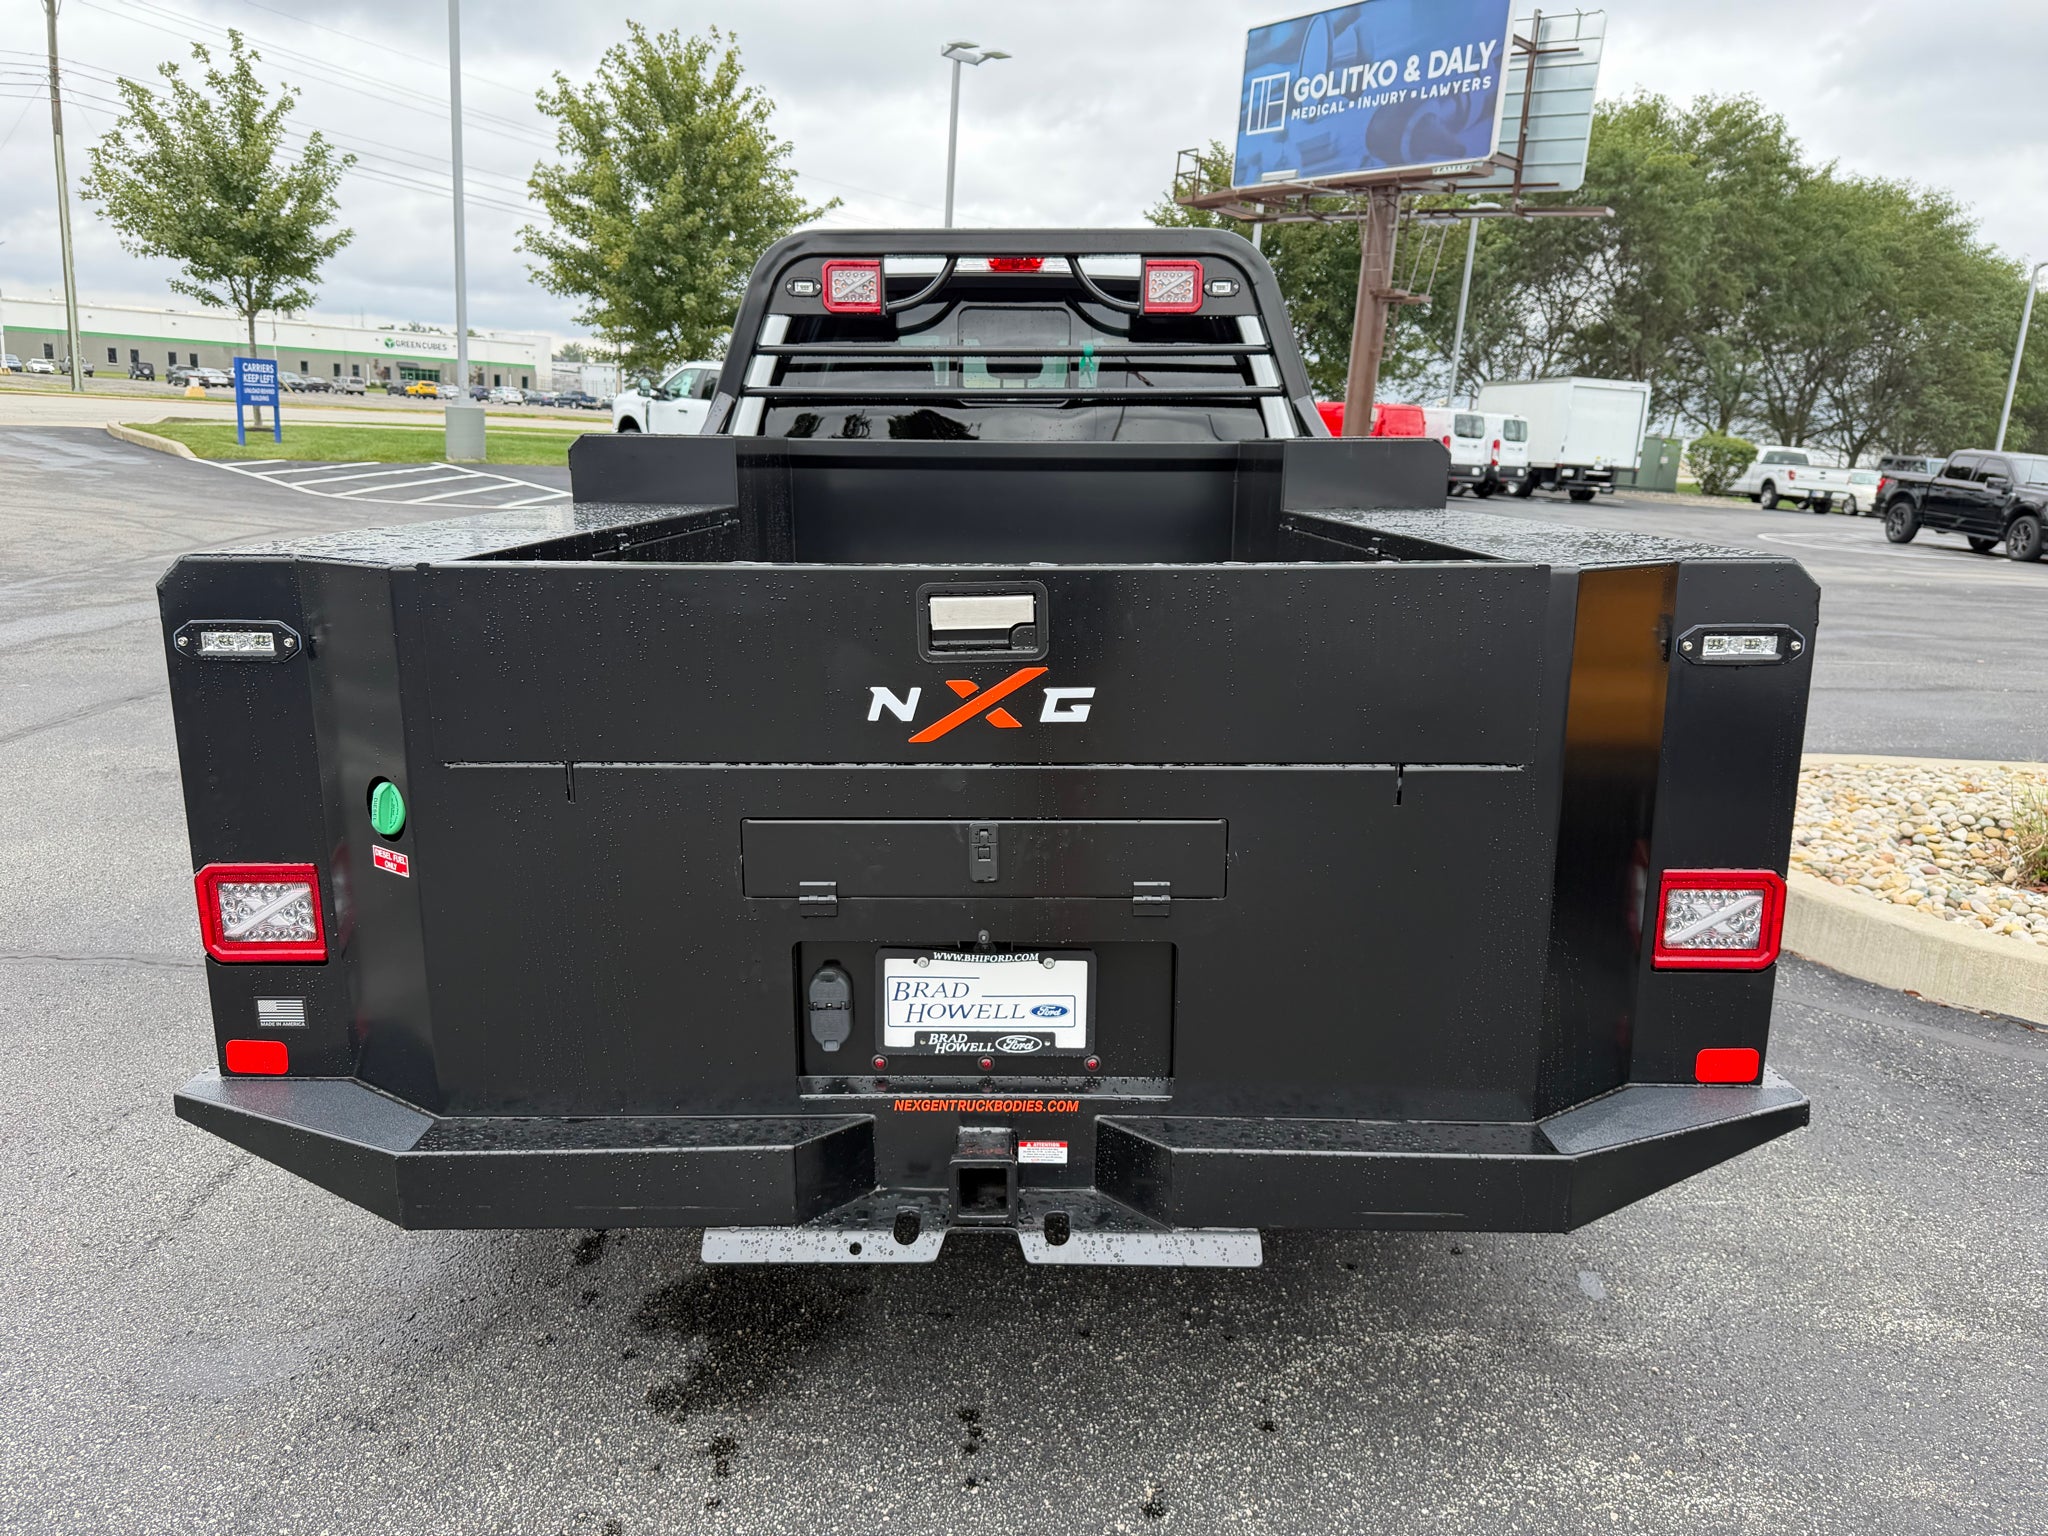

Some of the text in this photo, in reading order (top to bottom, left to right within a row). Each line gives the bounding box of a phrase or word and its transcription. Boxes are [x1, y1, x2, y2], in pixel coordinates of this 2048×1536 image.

[1293, 39, 1497, 102] GOLITKO & DALY
[1291, 76, 1492, 121] MEDICAL INJURY LAWYERS
[242, 362, 275, 373] CARRIERS
[243, 373, 275, 384] KEEP LEFT
[867, 666, 1096, 743] NXG
[374, 848, 406, 865] DIESEL FUEL
[384, 860, 398, 871] ONLY
[933, 951, 1040, 963] WWW.BHIFORD.COM
[892, 981, 970, 1002] BRAD
[904, 1003, 1063, 1024] HOWELL Ford
[928, 1033, 968, 1045] BRAD
[934, 1036, 1035, 1054] HOWELL Ford
[893, 1099, 1080, 1113] NEXGENTRUCKBODIES.COM
